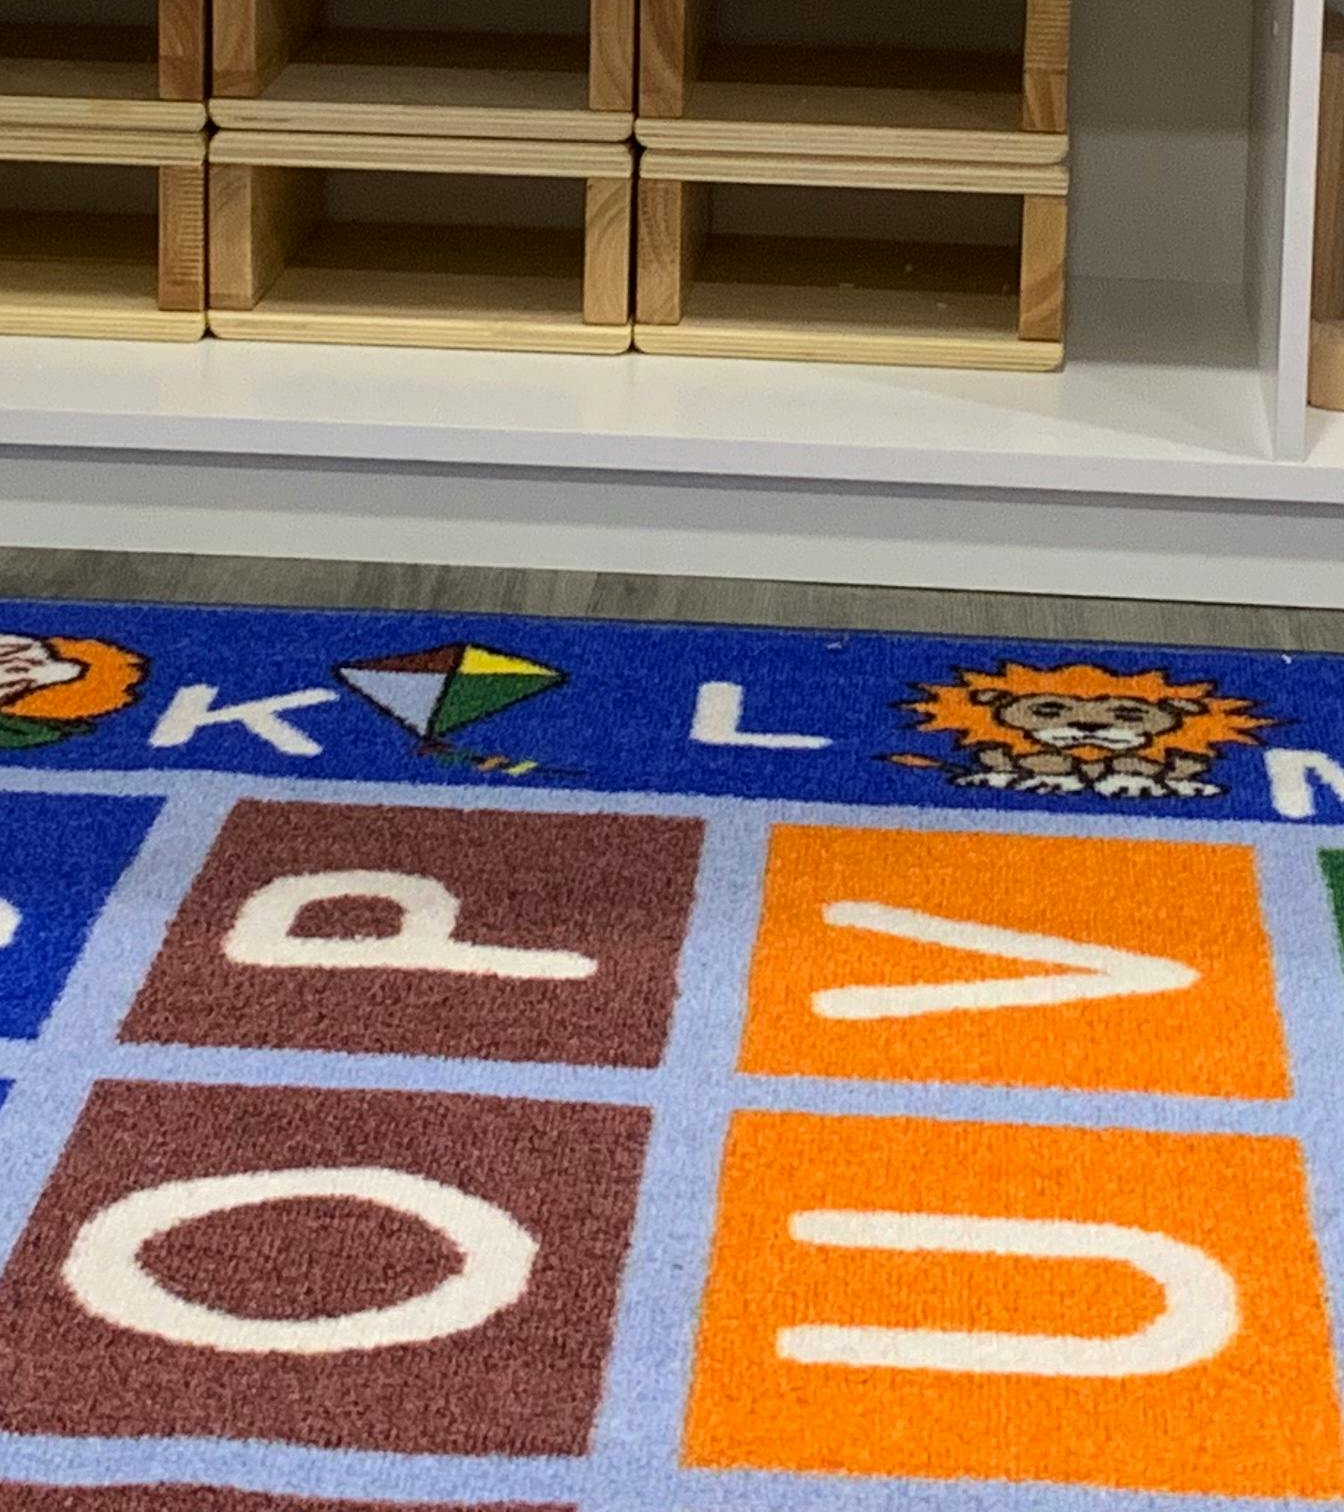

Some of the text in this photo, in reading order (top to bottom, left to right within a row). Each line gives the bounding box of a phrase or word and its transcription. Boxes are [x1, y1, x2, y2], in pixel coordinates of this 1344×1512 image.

[148, 684, 338, 757] K
[690, 681, 834, 750] L
[222, 869, 599, 980] P
[811, 900, 1199, 1020] V
[60, 1165, 541, 1355] O
[776, 1208, 1240, 1381] U
